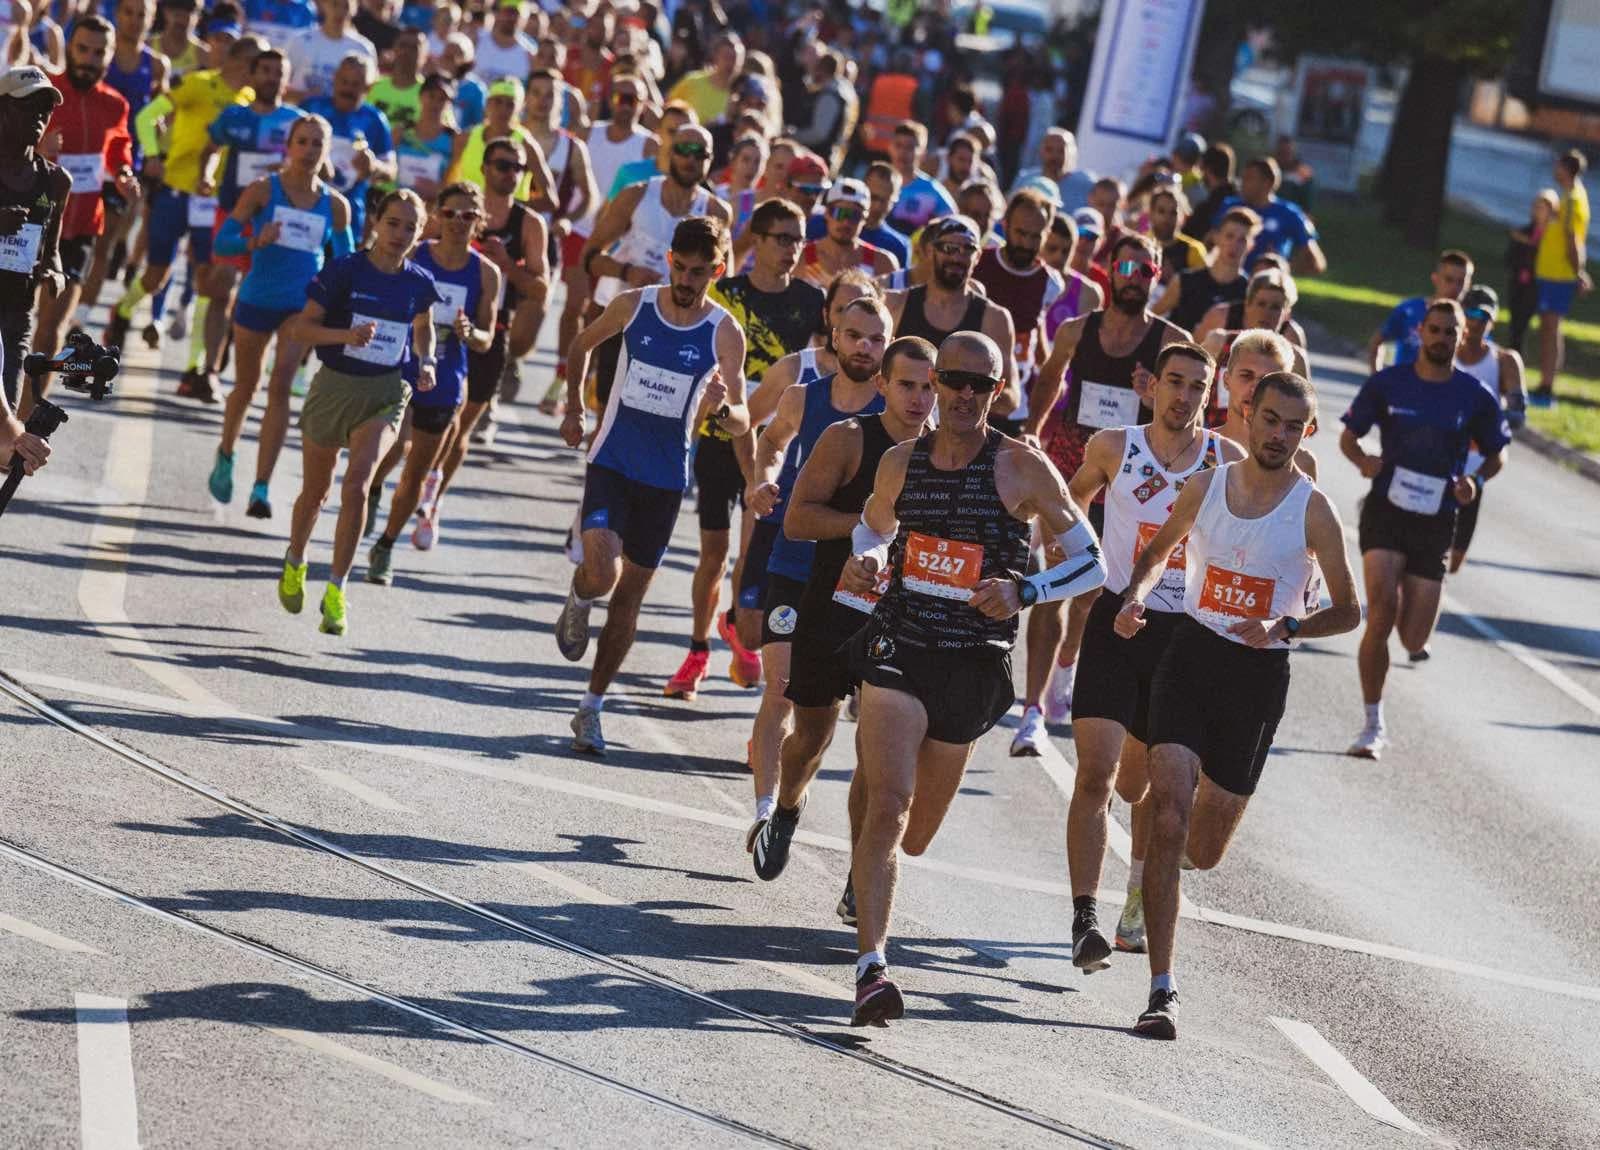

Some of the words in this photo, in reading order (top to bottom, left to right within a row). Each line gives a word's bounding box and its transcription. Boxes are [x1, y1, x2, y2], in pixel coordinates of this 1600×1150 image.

[64, 362, 92, 371] RONIN
[639, 377, 677, 395] MLADEN
[930, 492, 951, 501] PARK
[957, 506, 1001, 518] BROADWAY
[1213, 583, 1256, 608] 5176
[937, 640, 962, 649] LONG
